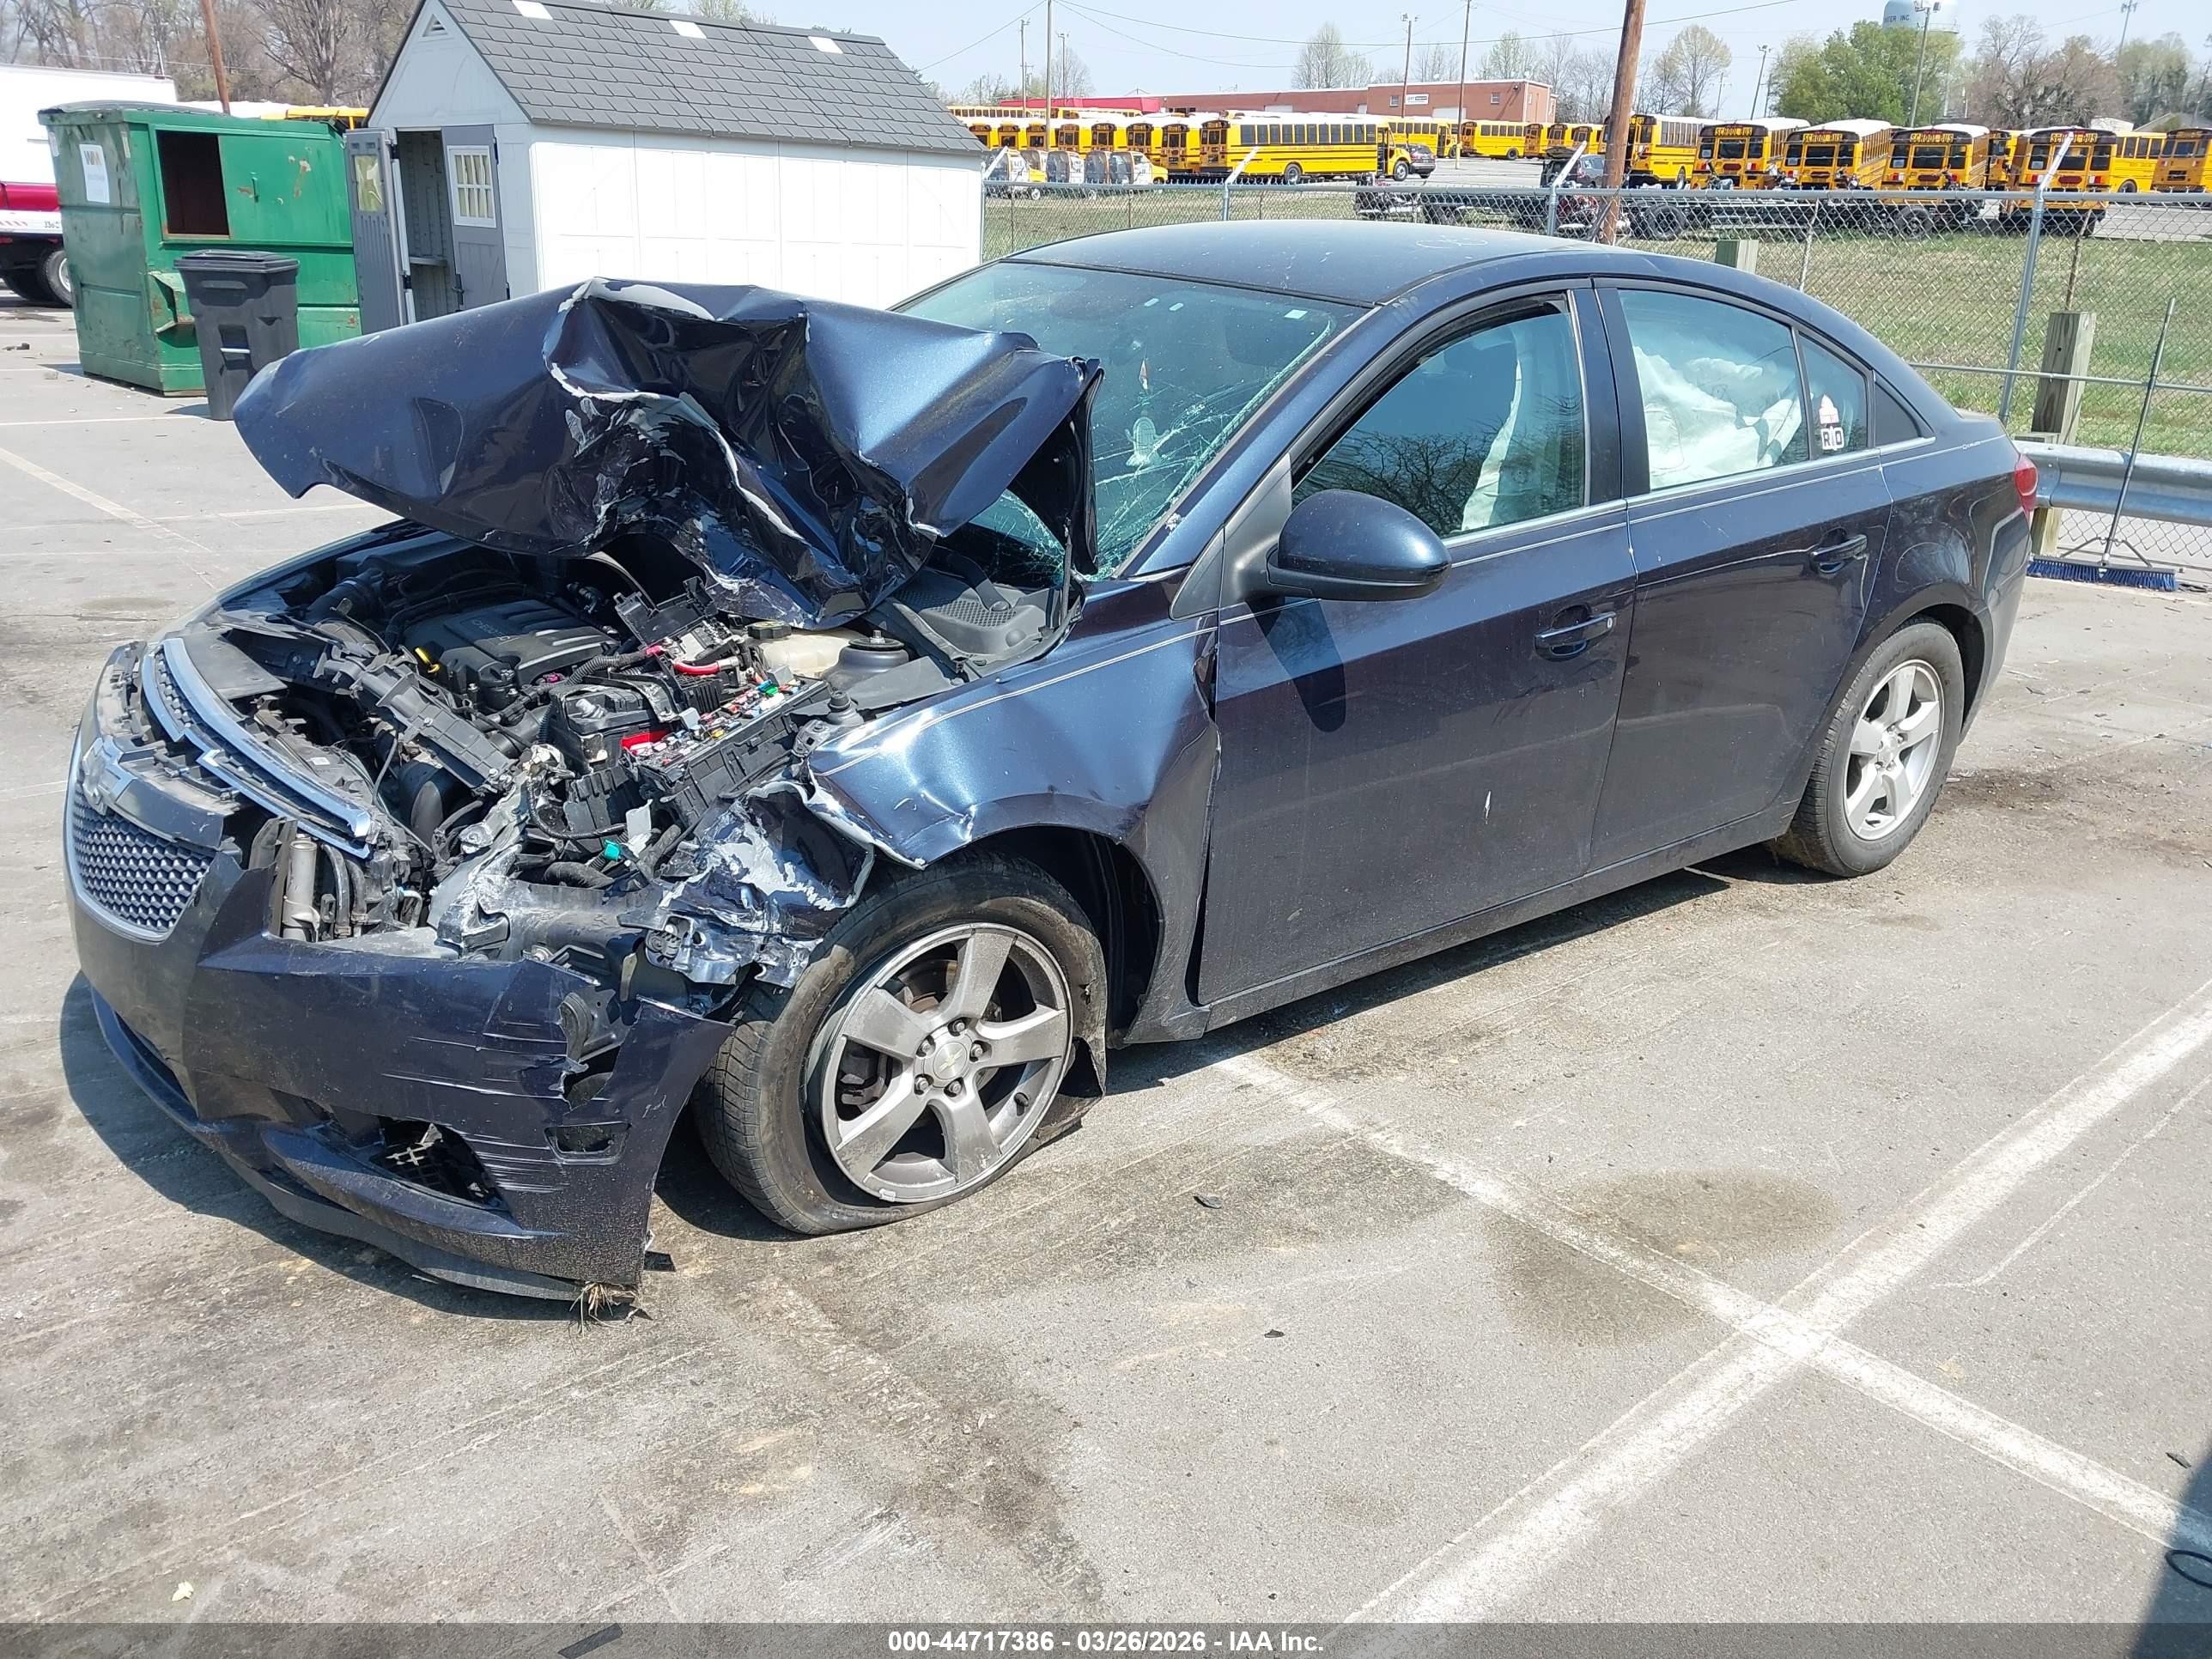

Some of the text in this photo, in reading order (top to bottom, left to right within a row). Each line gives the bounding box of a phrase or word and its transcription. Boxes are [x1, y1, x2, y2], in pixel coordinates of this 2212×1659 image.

[1716, 126, 1751, 137] SCHOOL BUS
[1803, 133, 1842, 142] SCHOOL BUS
[1911, 133, 1953, 143] SCHOOL BUS
[2083, 133, 2097, 143] BUS
